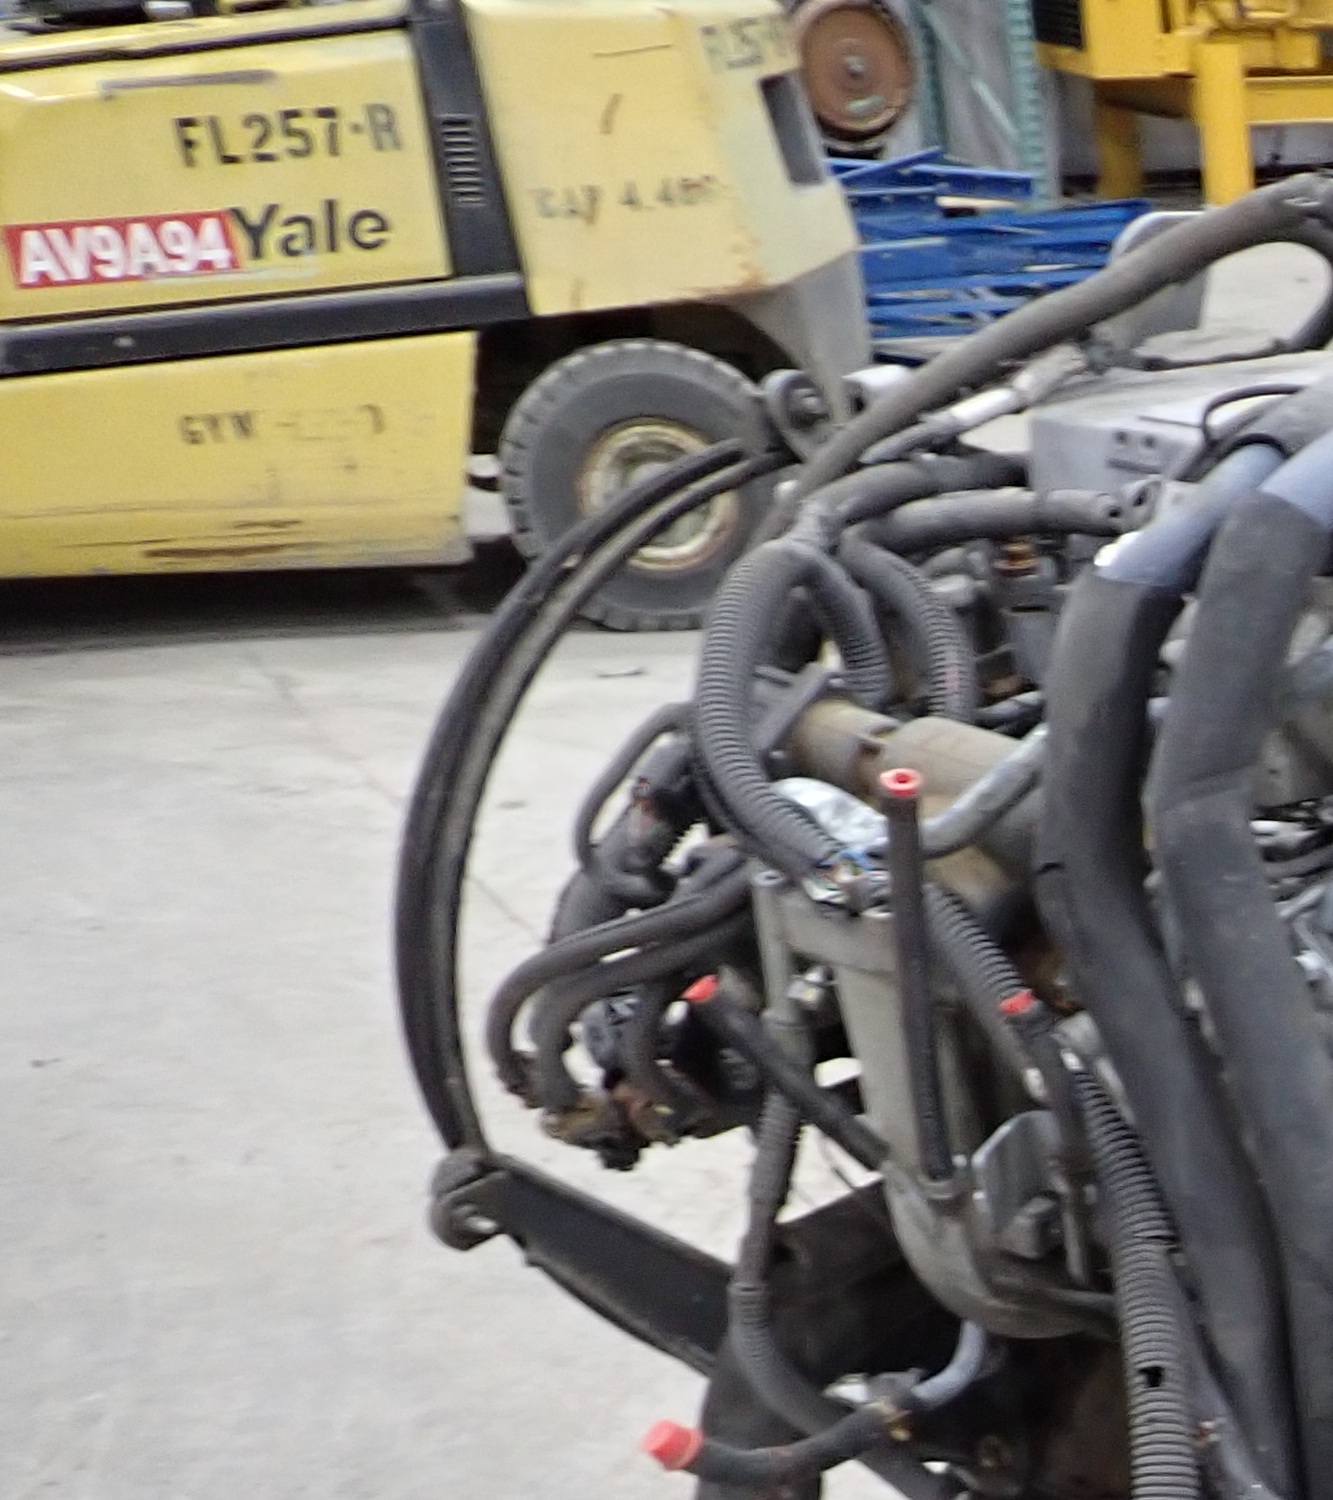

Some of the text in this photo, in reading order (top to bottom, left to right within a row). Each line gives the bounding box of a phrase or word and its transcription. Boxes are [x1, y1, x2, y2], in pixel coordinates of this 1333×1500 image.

[174, 103, 402, 168] FL257-R
[19, 217, 234, 284] AV9A94
[231, 198, 390, 260] Yale
